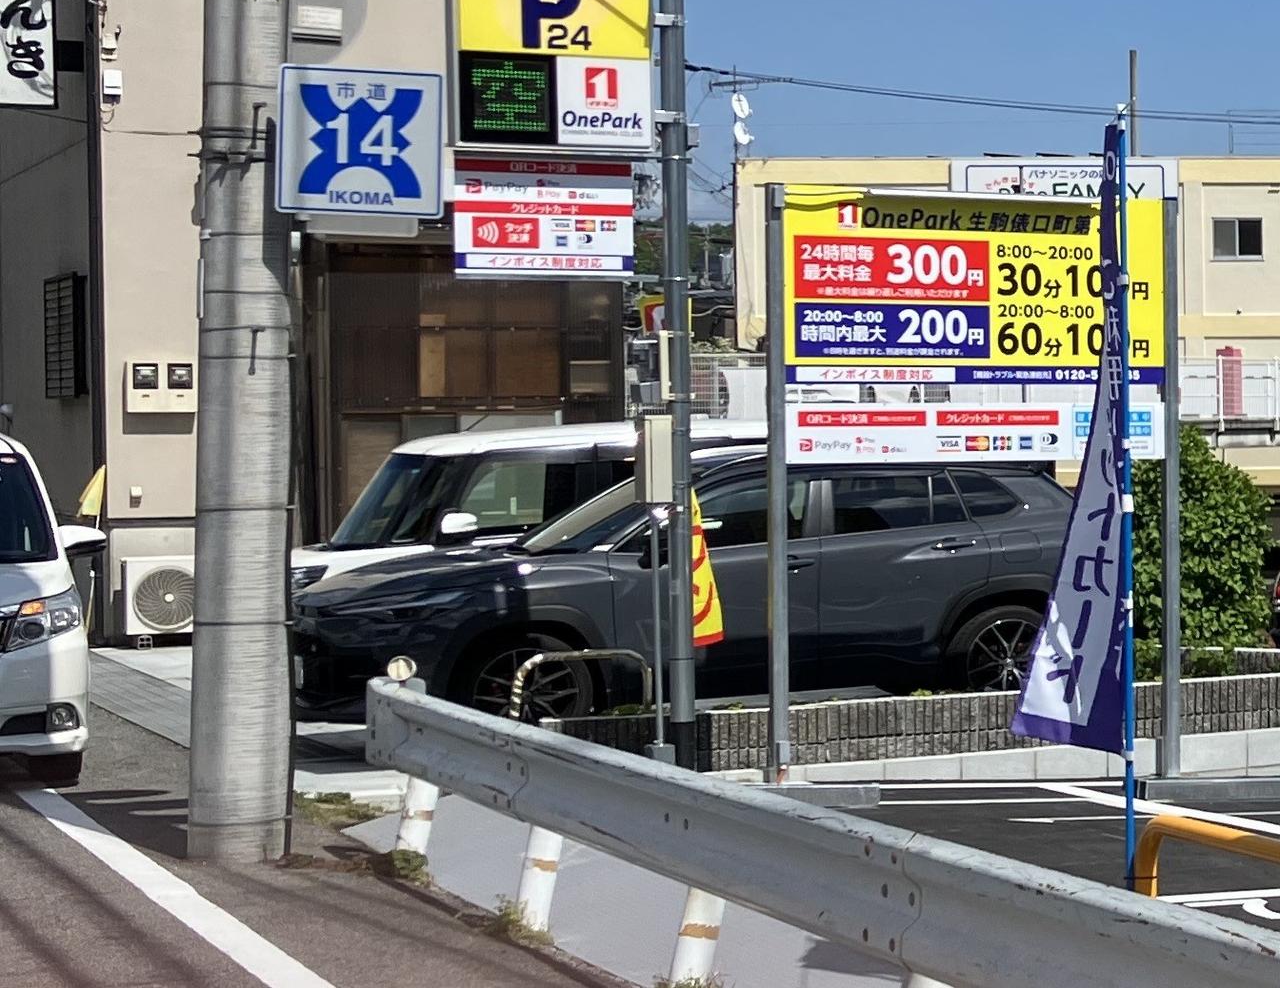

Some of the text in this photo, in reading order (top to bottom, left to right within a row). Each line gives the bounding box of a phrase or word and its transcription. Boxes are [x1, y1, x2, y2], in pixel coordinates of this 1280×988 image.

[547, 23, 592, 51] 24
[335, 82, 387, 101] 市道
[472, 60, 546, 132] 空
[562, 110, 643, 130] OnePark
[326, 113, 400, 167] 14
[484, 181, 529, 195] PayPay
[328, 189, 395, 207] IKOMA
[511, 202, 579, 215] クレジットカード
[504, 222, 534, 234] タッチ
[861, 206, 962, 231] OnePark
[800, 243, 875, 263] 24時間毎
[488, 256, 603, 270] インボイス制度対応
[886, 243, 985, 288] 300円
[802, 263, 872, 283] 最大料金
[800, 324, 887, 343] 時間内最大
[896, 309, 985, 346] 200円
[819, 368, 934, 381] インボイス制度対応
[806, 413, 868, 425] QRコード決済
[946, 413, 1004, 424] クレジットカード
[814, 440, 852, 452] PayPay
[940, 440, 959, 448] VISA
